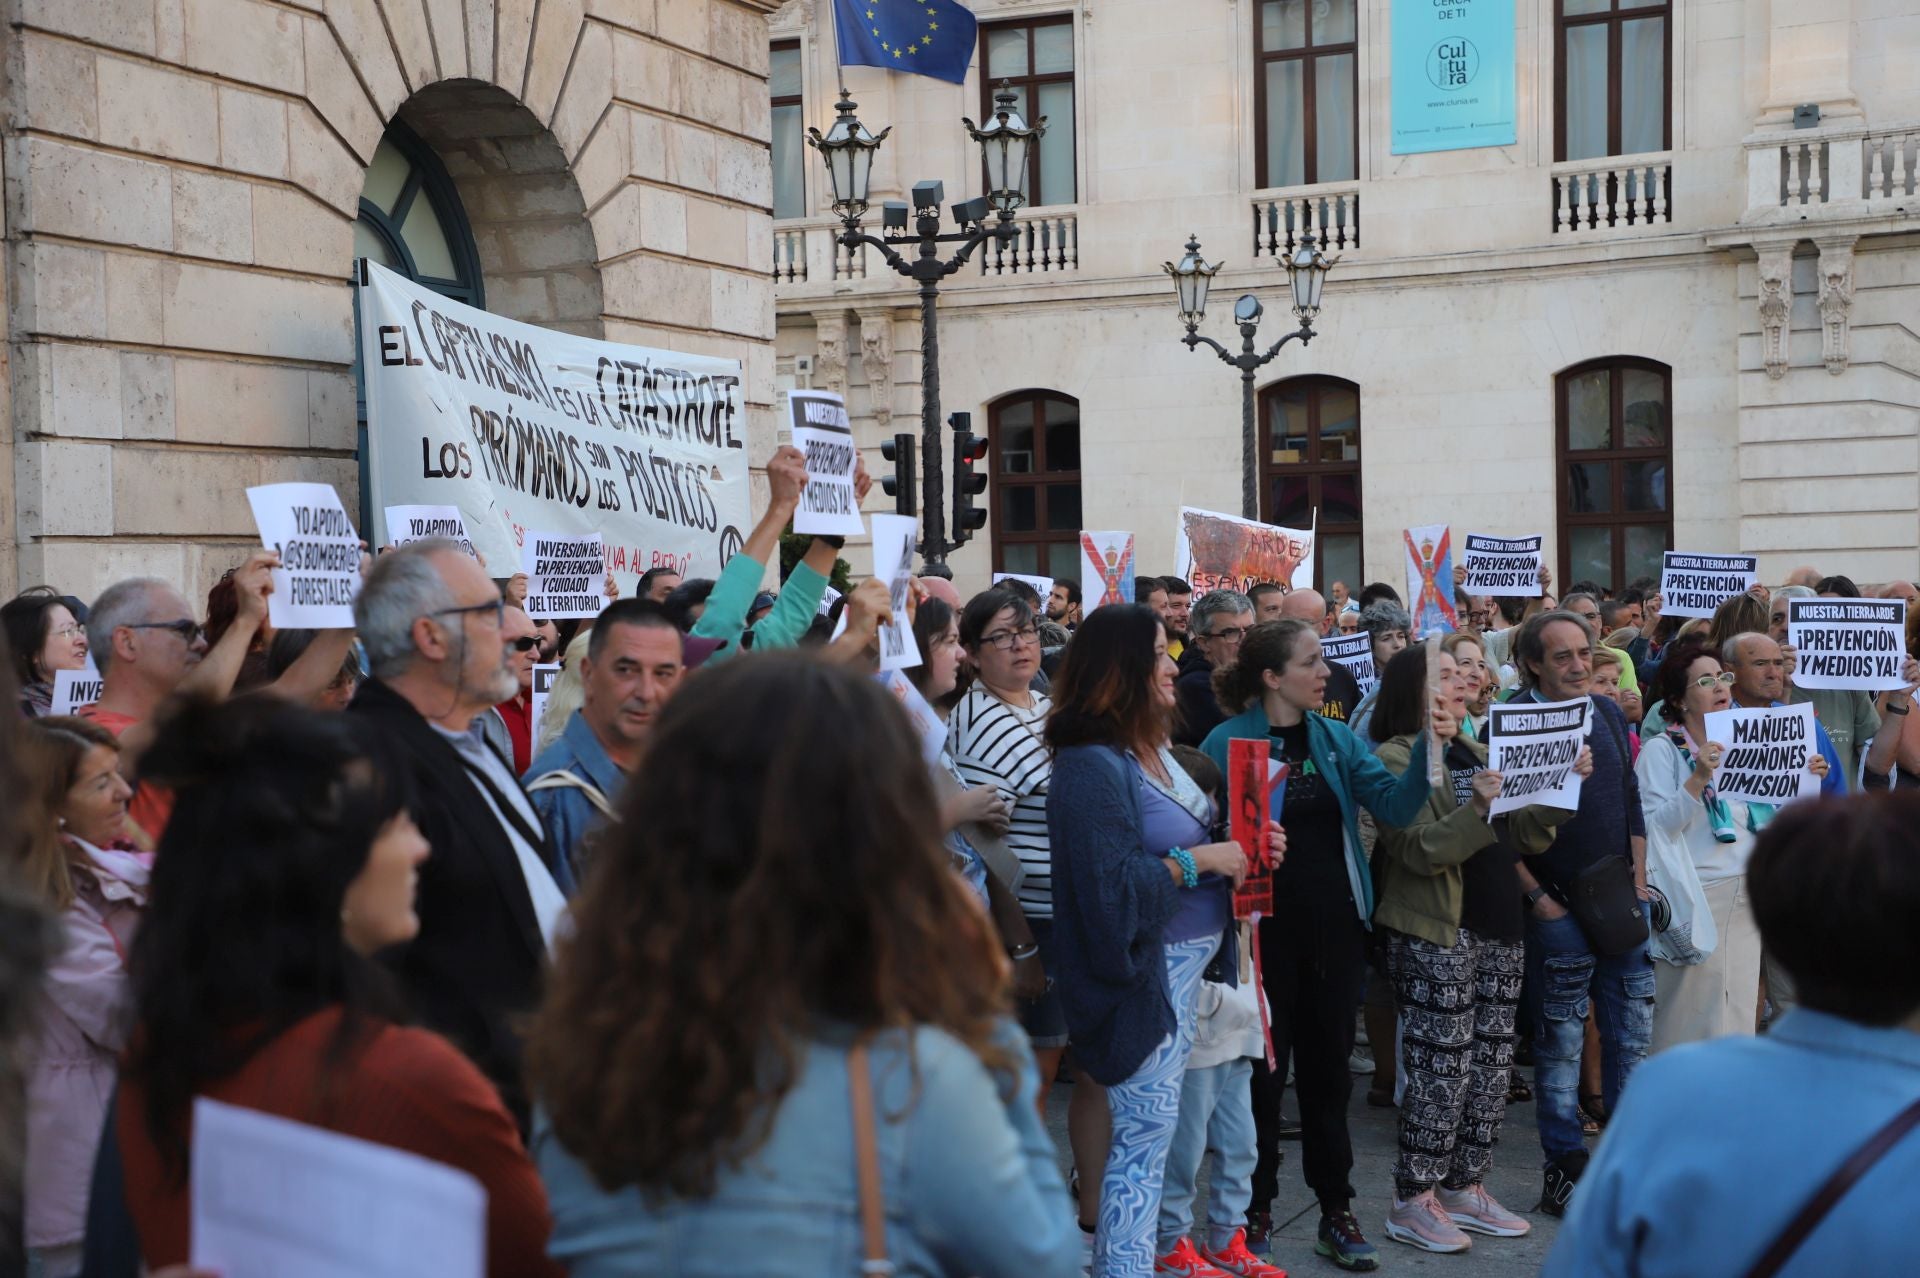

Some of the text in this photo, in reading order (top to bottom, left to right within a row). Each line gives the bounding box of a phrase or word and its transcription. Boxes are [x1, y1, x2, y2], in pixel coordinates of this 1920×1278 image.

[1438, 8, 1466, 20] DE TI
[379, 325, 423, 366] EL
[553, 386, 580, 420] ES
[577, 391, 602, 427] LA
[596, 356, 742, 448] CATÁSTROFE
[422, 403, 717, 533] LOS PIRÓMANOS SON LOS POLÍTICOS
[807, 481, 838, 514] MEDIOS
[838, 483, 851, 515] YA!
[291, 506, 352, 538] YO APOYO A
[410, 518, 465, 536] YO APOYO A
[536, 540, 589, 558] INVERSIÓN
[1251, 533, 1302, 558] ARDE
[1472, 538, 1504, 551] NUESTRA
[1505, 542, 1527, 552] TIERRA
[535, 557, 603, 576] EN PREVENCIÓN
[630, 549, 645, 575] AL
[1467, 554, 1538, 571] ¡PREVENCIÓN
[1671, 557, 1750, 570] NUESTRA TIERRA ARDE
[542, 577, 590, 592] Y CUIDADO
[1467, 573, 1535, 587] Y MEDIOS YA!
[1666, 573, 1746, 592] ¡PREVENCIÓN
[291, 577, 354, 606] FORESTALES
[1667, 591, 1676, 606] Y
[1677, 592, 1724, 610] MEDIOS
[530, 595, 600, 612] DEL TERRITORIO
[1799, 605, 1895, 620] NUESTRA TIERRA ARDE
[1338, 641, 1361, 656] TIERRA
[1797, 626, 1898, 651] ¡PREVENCIÓN
[1801, 655, 1899, 677] Y MEDIOS YA!
[1501, 713, 1542, 732] NUESTRA
[1543, 710, 1568, 730] TIERRA
[1733, 714, 1805, 743] MAÑUECO
[1499, 735, 1579, 772] ¡PREVENCIÓN
[1724, 743, 1807, 770] QUIÑONES
[1501, 770, 1550, 798] MEDIOS
[1545, 767, 1571, 791] YA!
[1717, 771, 1801, 798] DIMISIÓN
